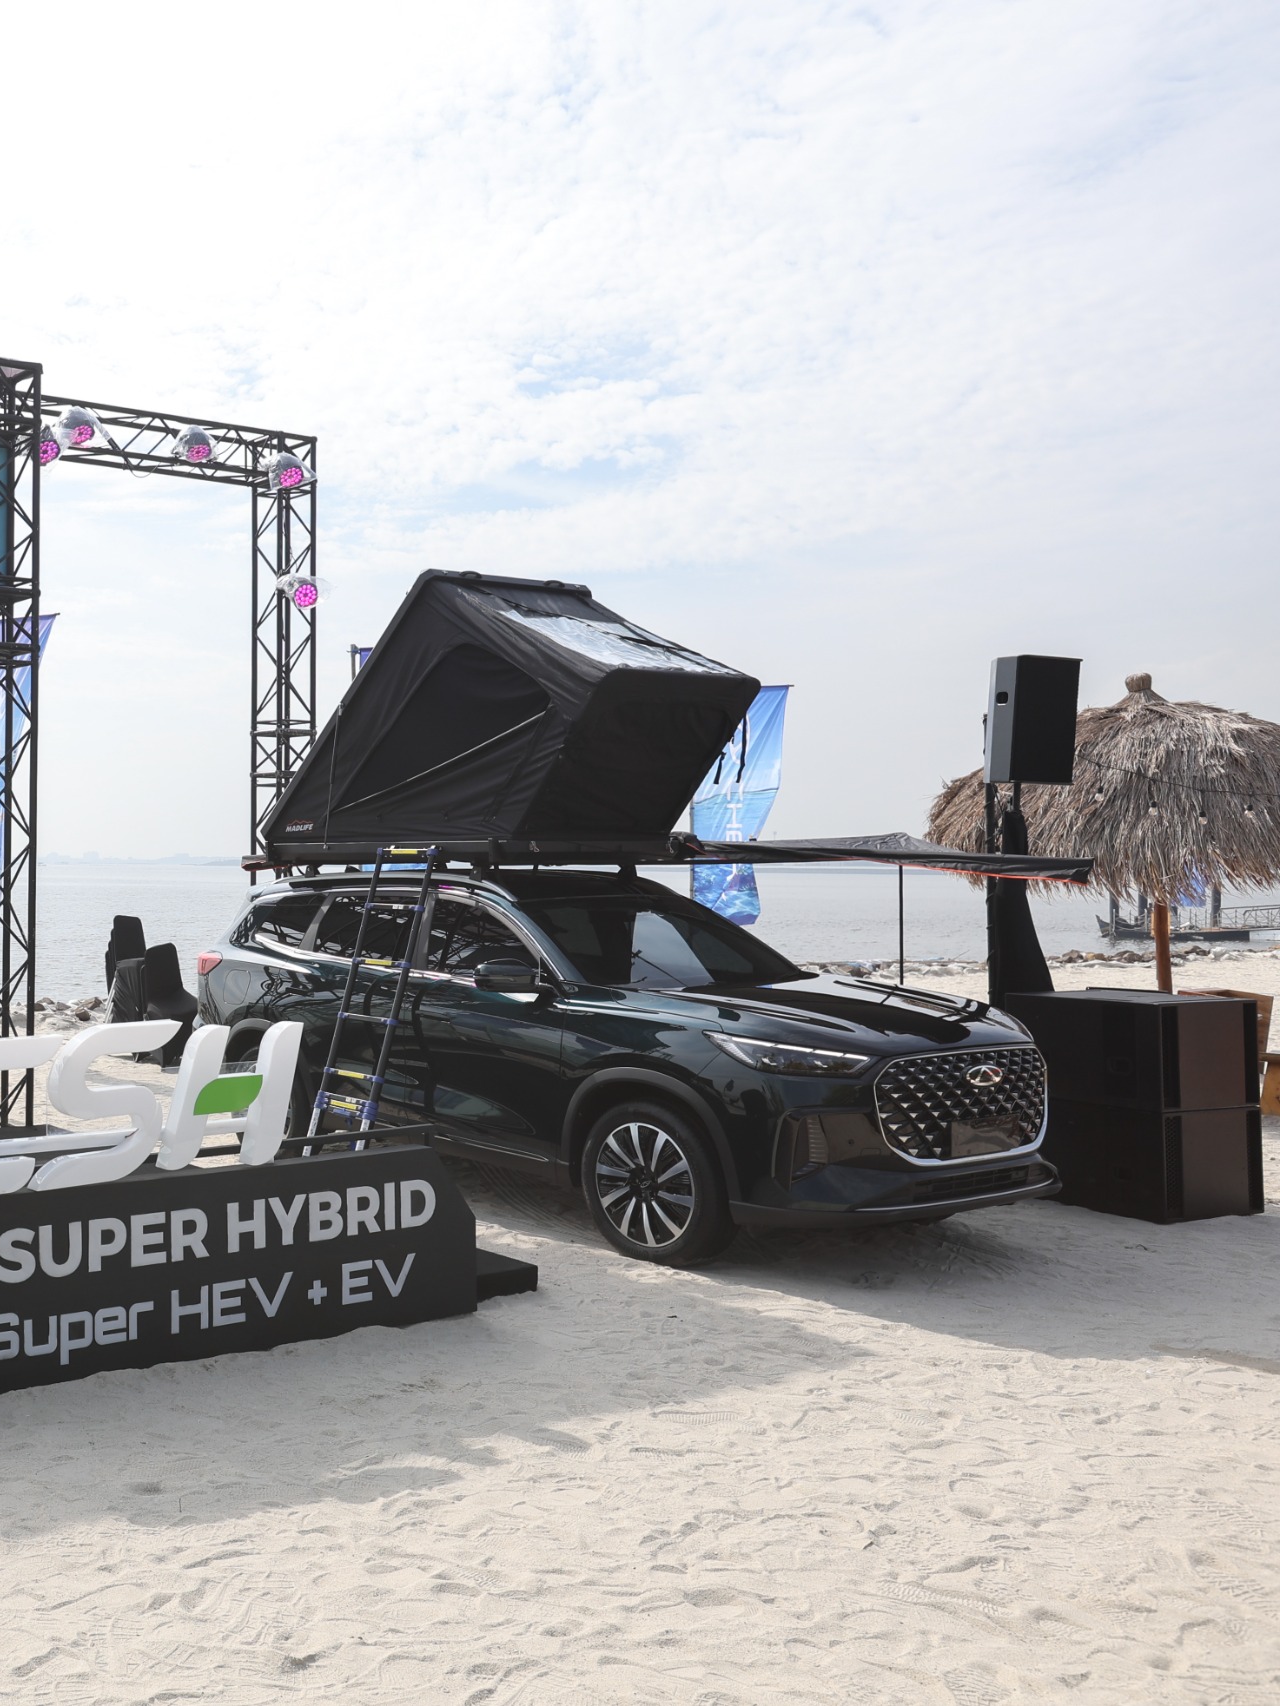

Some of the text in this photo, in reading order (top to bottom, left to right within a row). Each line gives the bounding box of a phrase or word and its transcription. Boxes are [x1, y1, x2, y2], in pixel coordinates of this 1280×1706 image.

[285, 824, 314, 833] MADLIFE
[227, 1180, 436, 1254] HYBRID
[171, 1271, 294, 1336] HEV
[307, 1279, 328, 1306] +
[342, 1253, 417, 1306] EV
